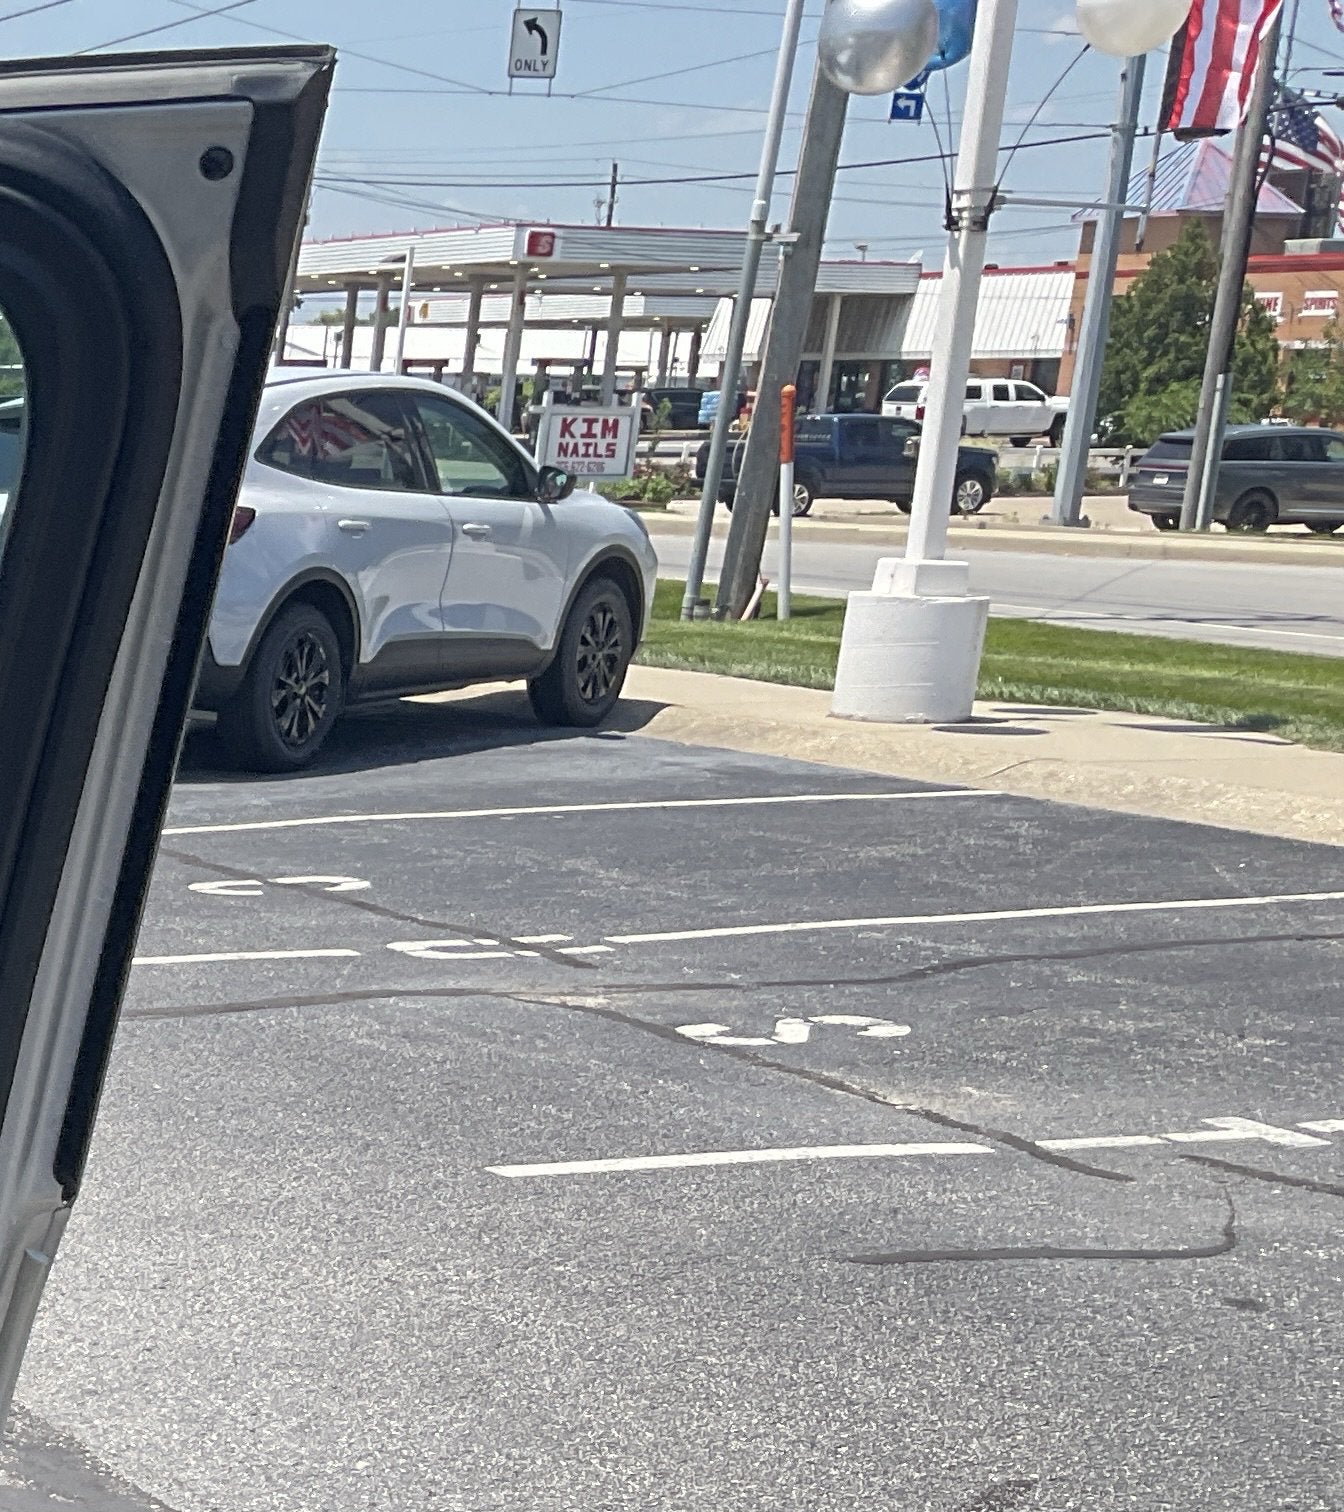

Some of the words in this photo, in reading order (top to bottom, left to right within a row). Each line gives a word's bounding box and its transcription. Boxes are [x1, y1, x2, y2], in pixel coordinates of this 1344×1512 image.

[514, 58, 549, 72] ONLY
[559, 417, 619, 439] KIM
[557, 442, 616, 458] NAILS
